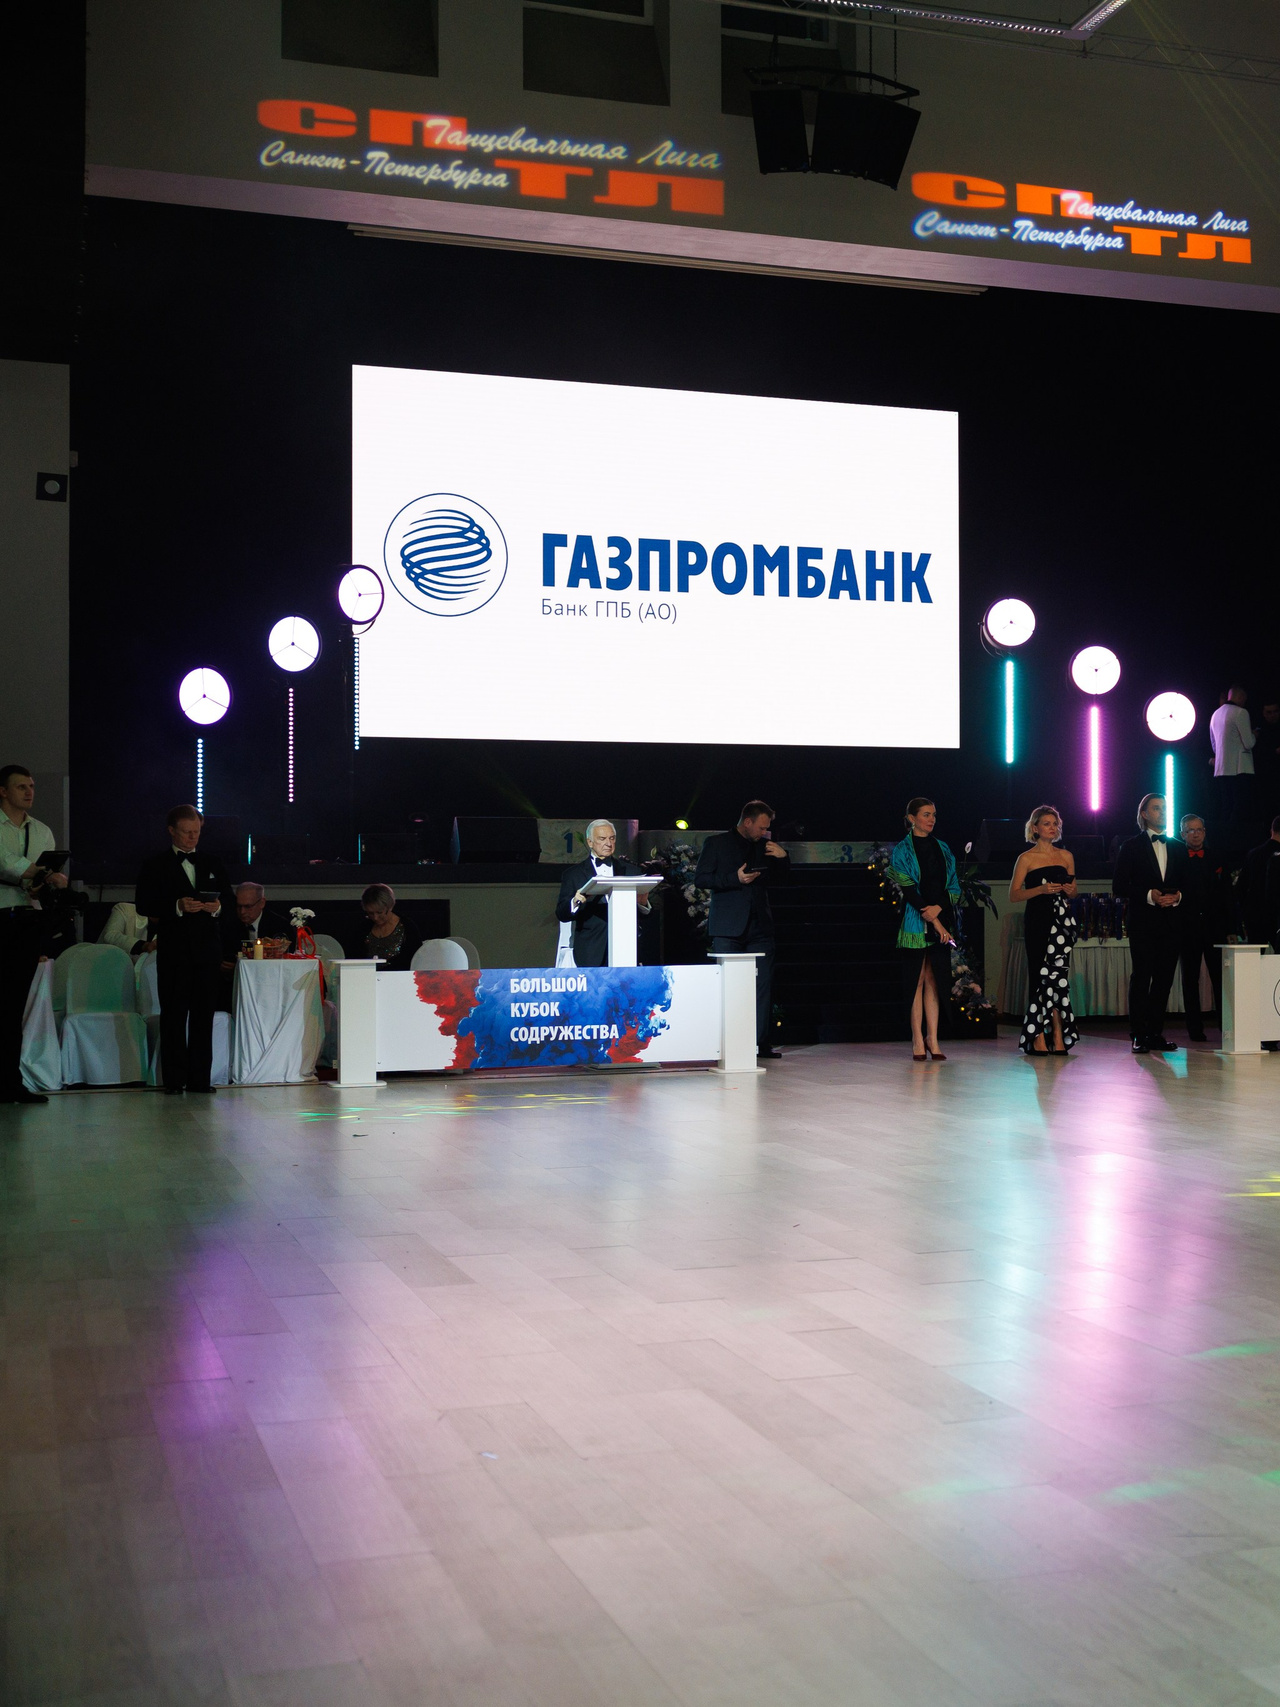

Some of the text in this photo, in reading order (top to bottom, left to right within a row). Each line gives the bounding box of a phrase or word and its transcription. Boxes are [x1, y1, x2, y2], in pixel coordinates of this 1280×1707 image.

[424, 118, 724, 170] Танцевальная Лига
[1061, 192, 1250, 233] Танцевальная Лига
[541, 532, 933, 604] ГАЗПРОМБАНК
[542, 598, 677, 624] Банк ГПБ (АО)
[509, 974, 588, 994] БОЛЬШОЙ
[510, 1001, 560, 1018] КУБОК
[509, 1023, 619, 1044] СОДРУЖЕСТВА
